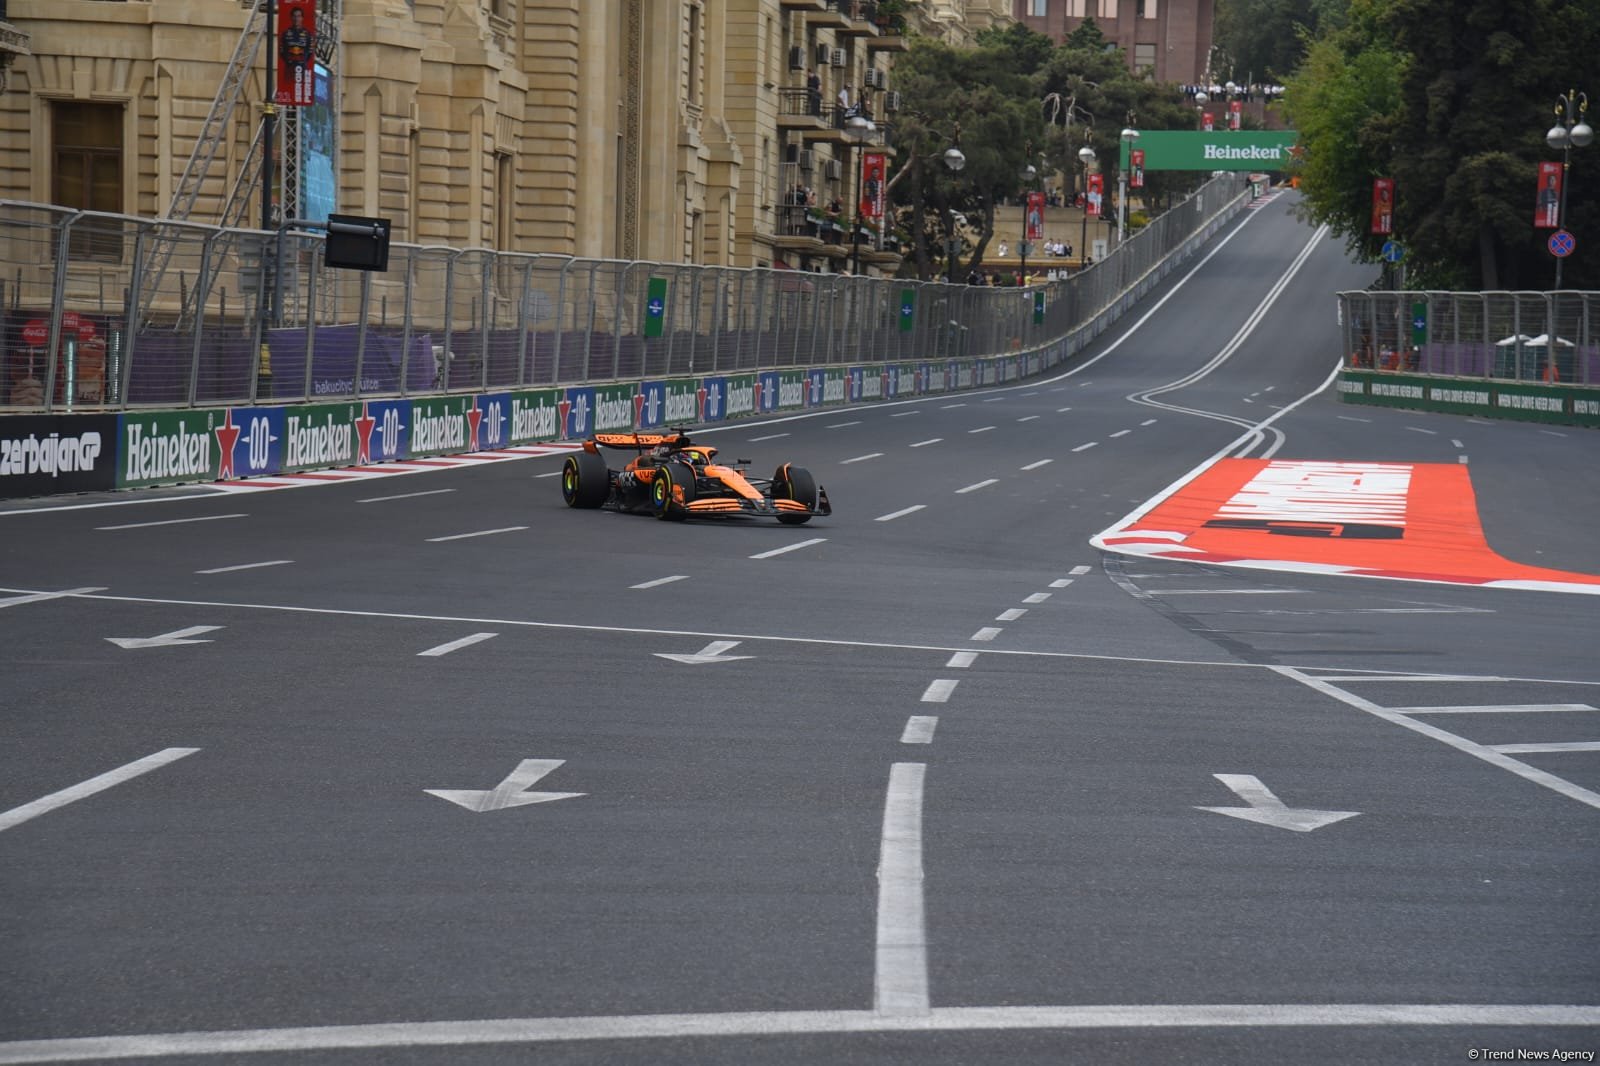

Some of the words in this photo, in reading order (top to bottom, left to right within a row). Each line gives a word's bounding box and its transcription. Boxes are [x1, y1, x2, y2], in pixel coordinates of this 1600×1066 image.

[304, 69, 312, 103] PEREZ
[1204, 145, 1281, 159] Heineken
[664, 385, 696, 422] Heineken
[727, 380, 753, 415] Heineken
[779, 375, 802, 407] Heineken
[412, 405, 463, 452] Heineken
[511, 398, 556, 440] Heineken
[595, 391, 632, 430] Heineken
[126, 421, 210, 481] Heineken
[250, 416, 269, 470] 0.0
[287, 414, 351, 467] Heineken
[382, 407, 398, 456] 0.0
